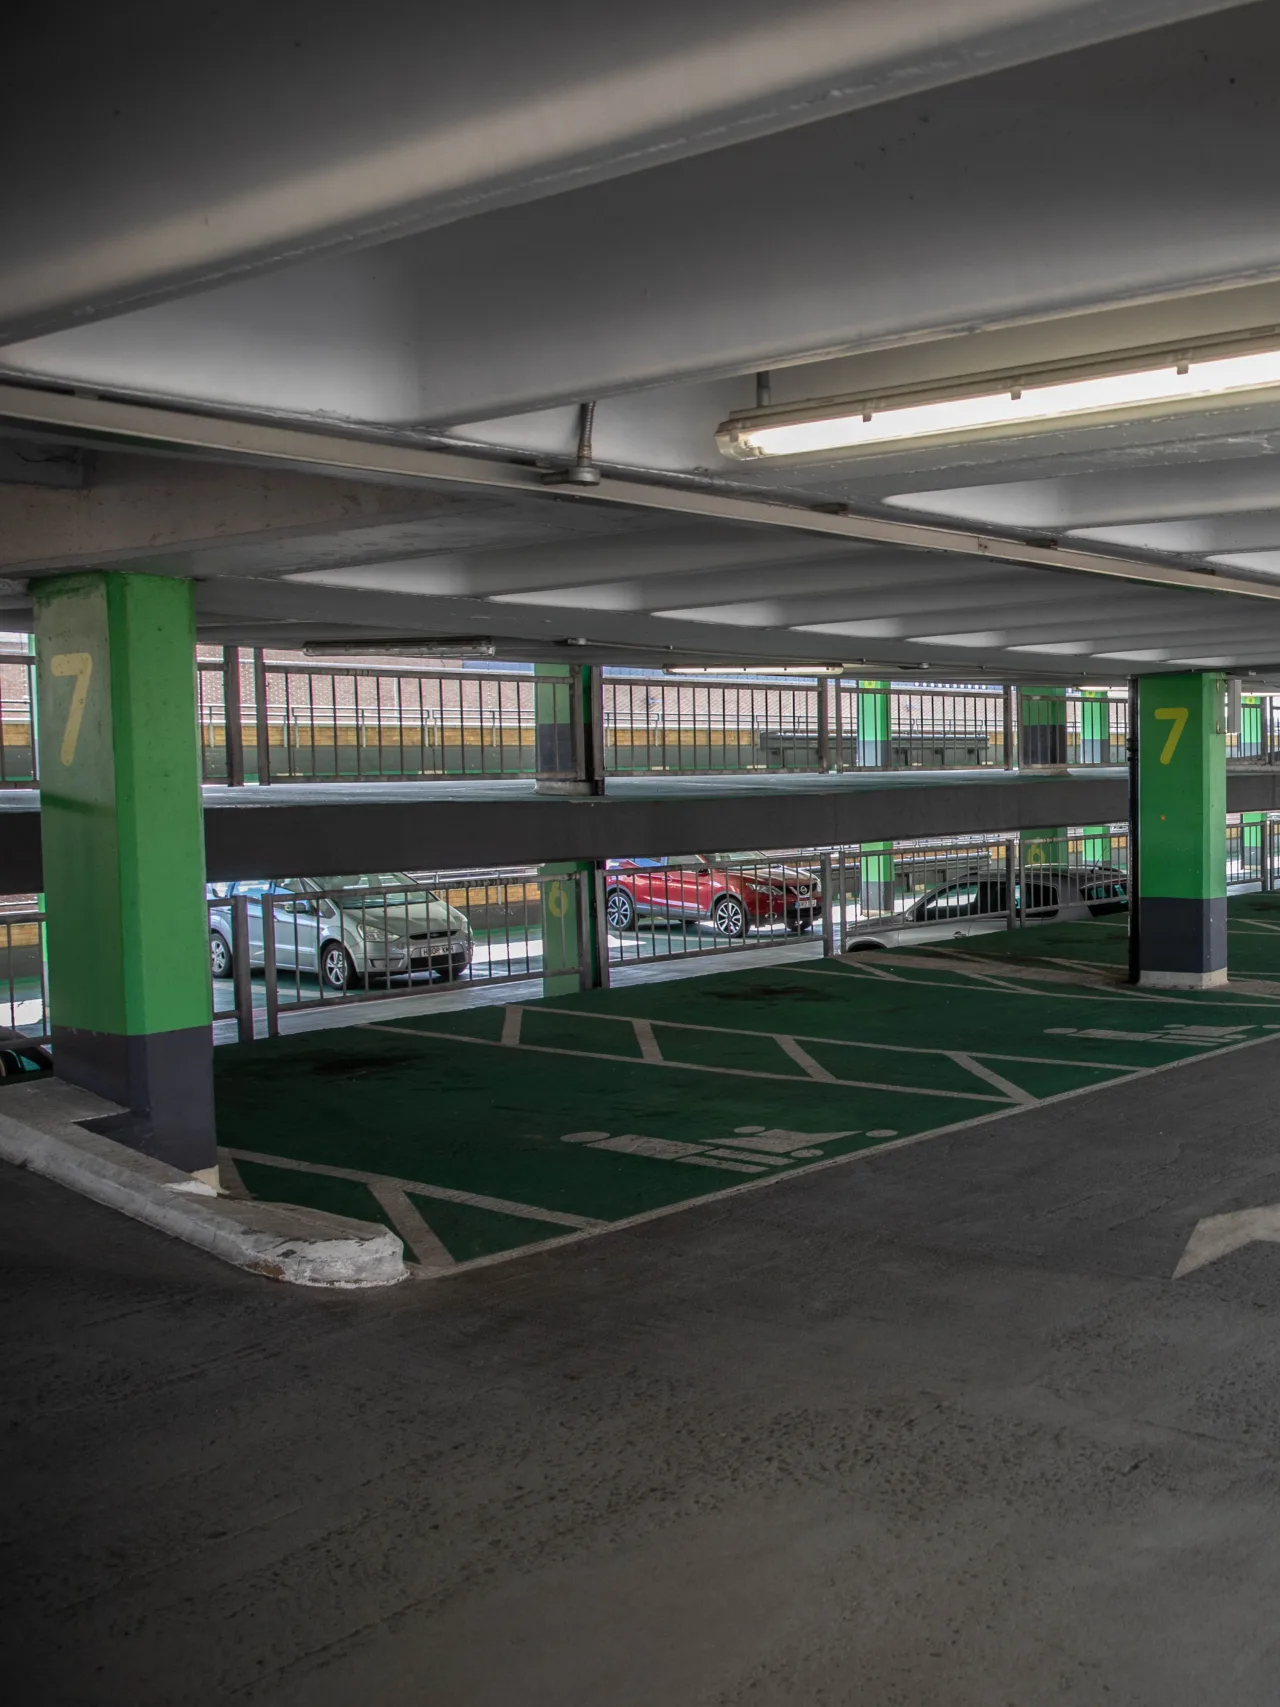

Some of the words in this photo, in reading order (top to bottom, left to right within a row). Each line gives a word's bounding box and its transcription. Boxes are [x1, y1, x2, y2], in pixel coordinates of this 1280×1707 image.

[51, 653, 92, 766] 7
[1154, 708, 1188, 765] 7
[549, 881, 568, 917] 6
